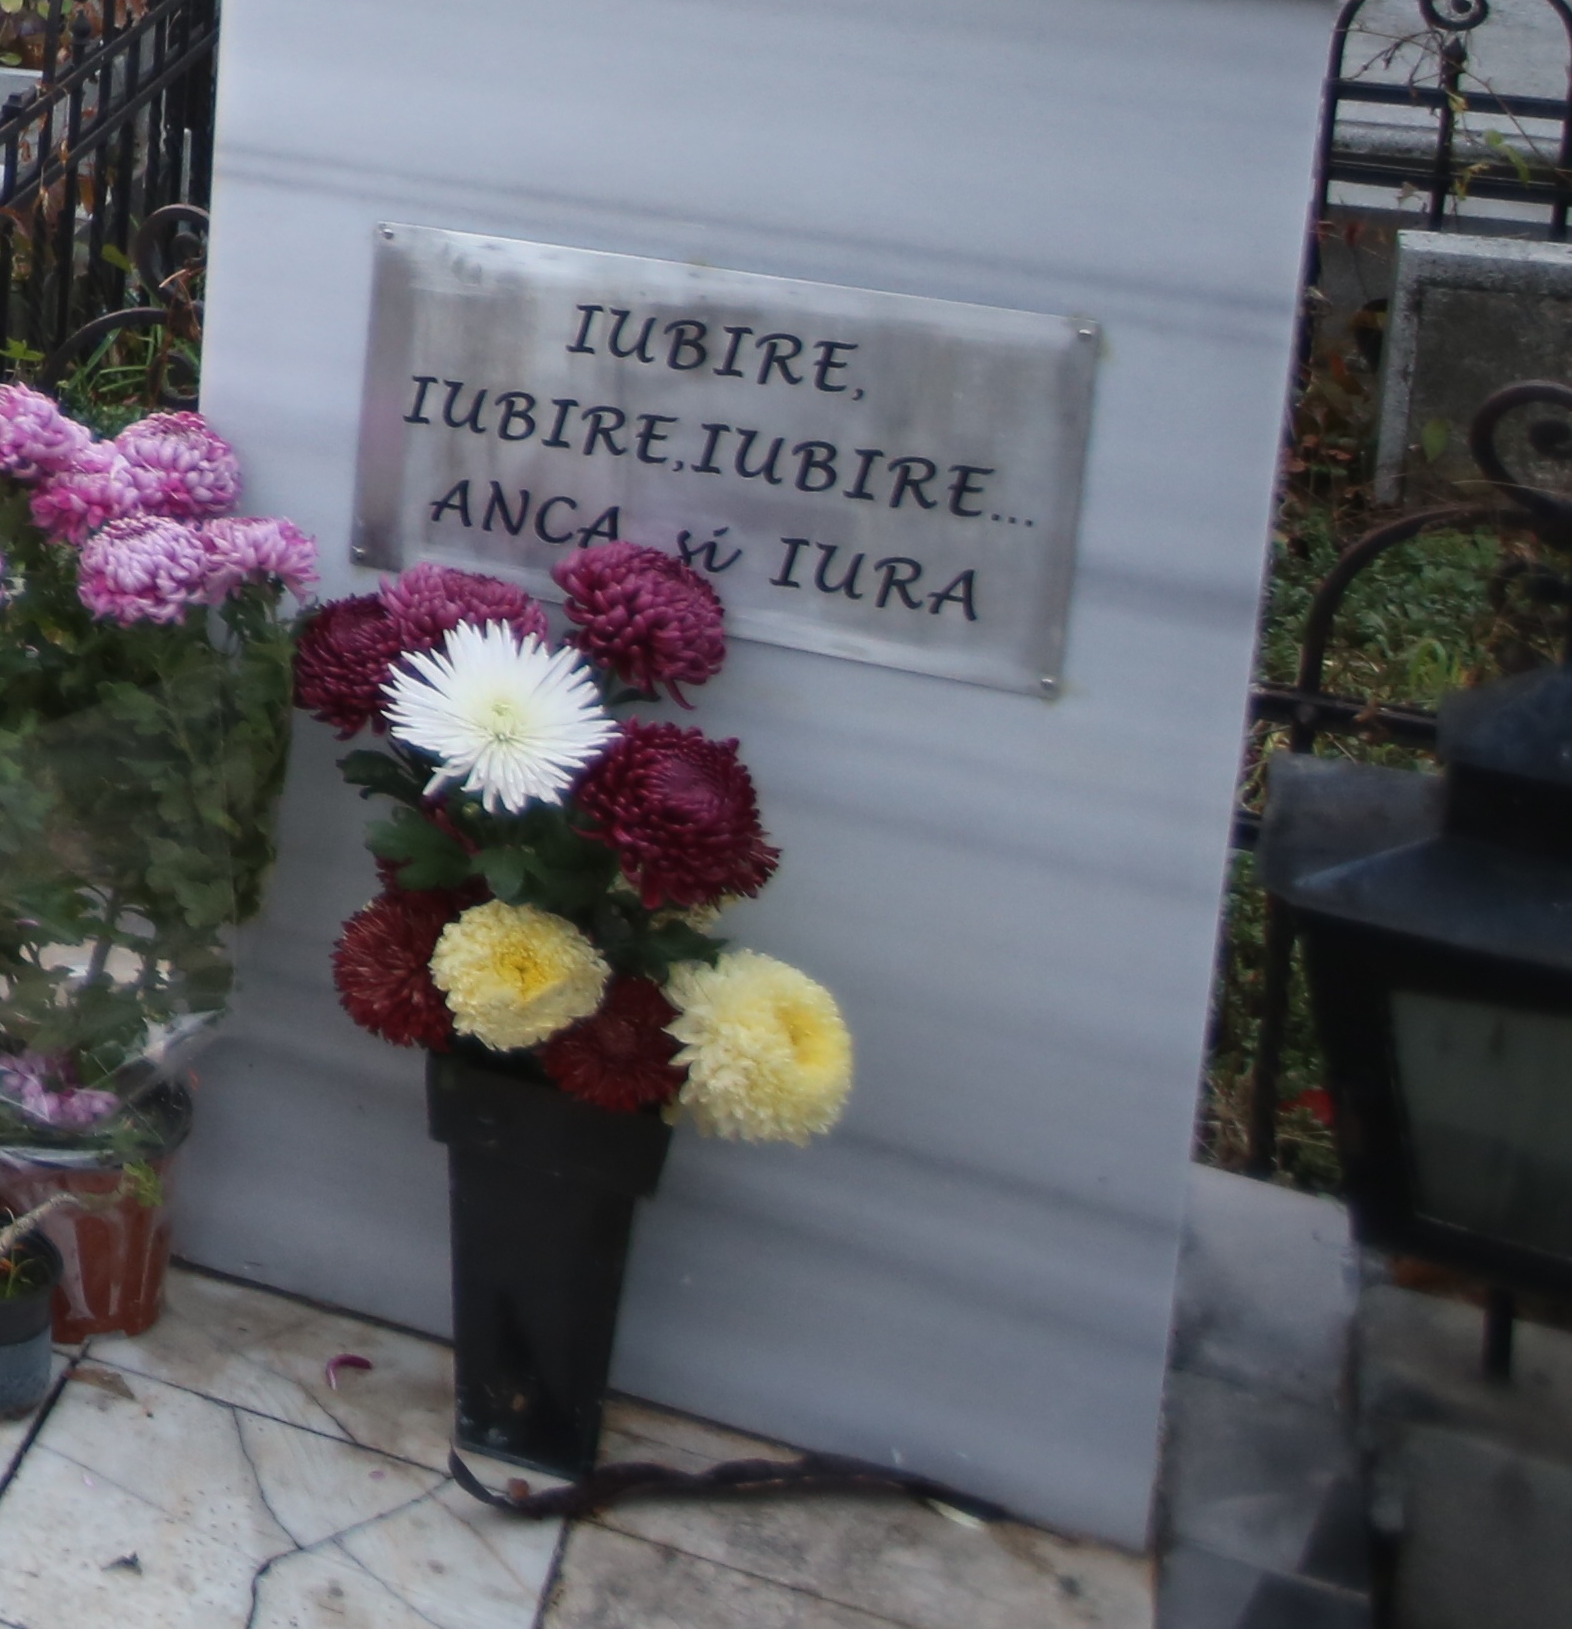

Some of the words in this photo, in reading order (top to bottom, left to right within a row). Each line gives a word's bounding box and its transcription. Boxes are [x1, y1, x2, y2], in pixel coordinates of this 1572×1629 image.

[566, 303, 865, 402] IUBIRE,
[430, 479, 621, 544] ANCA
[768, 537, 982, 623] IURA
